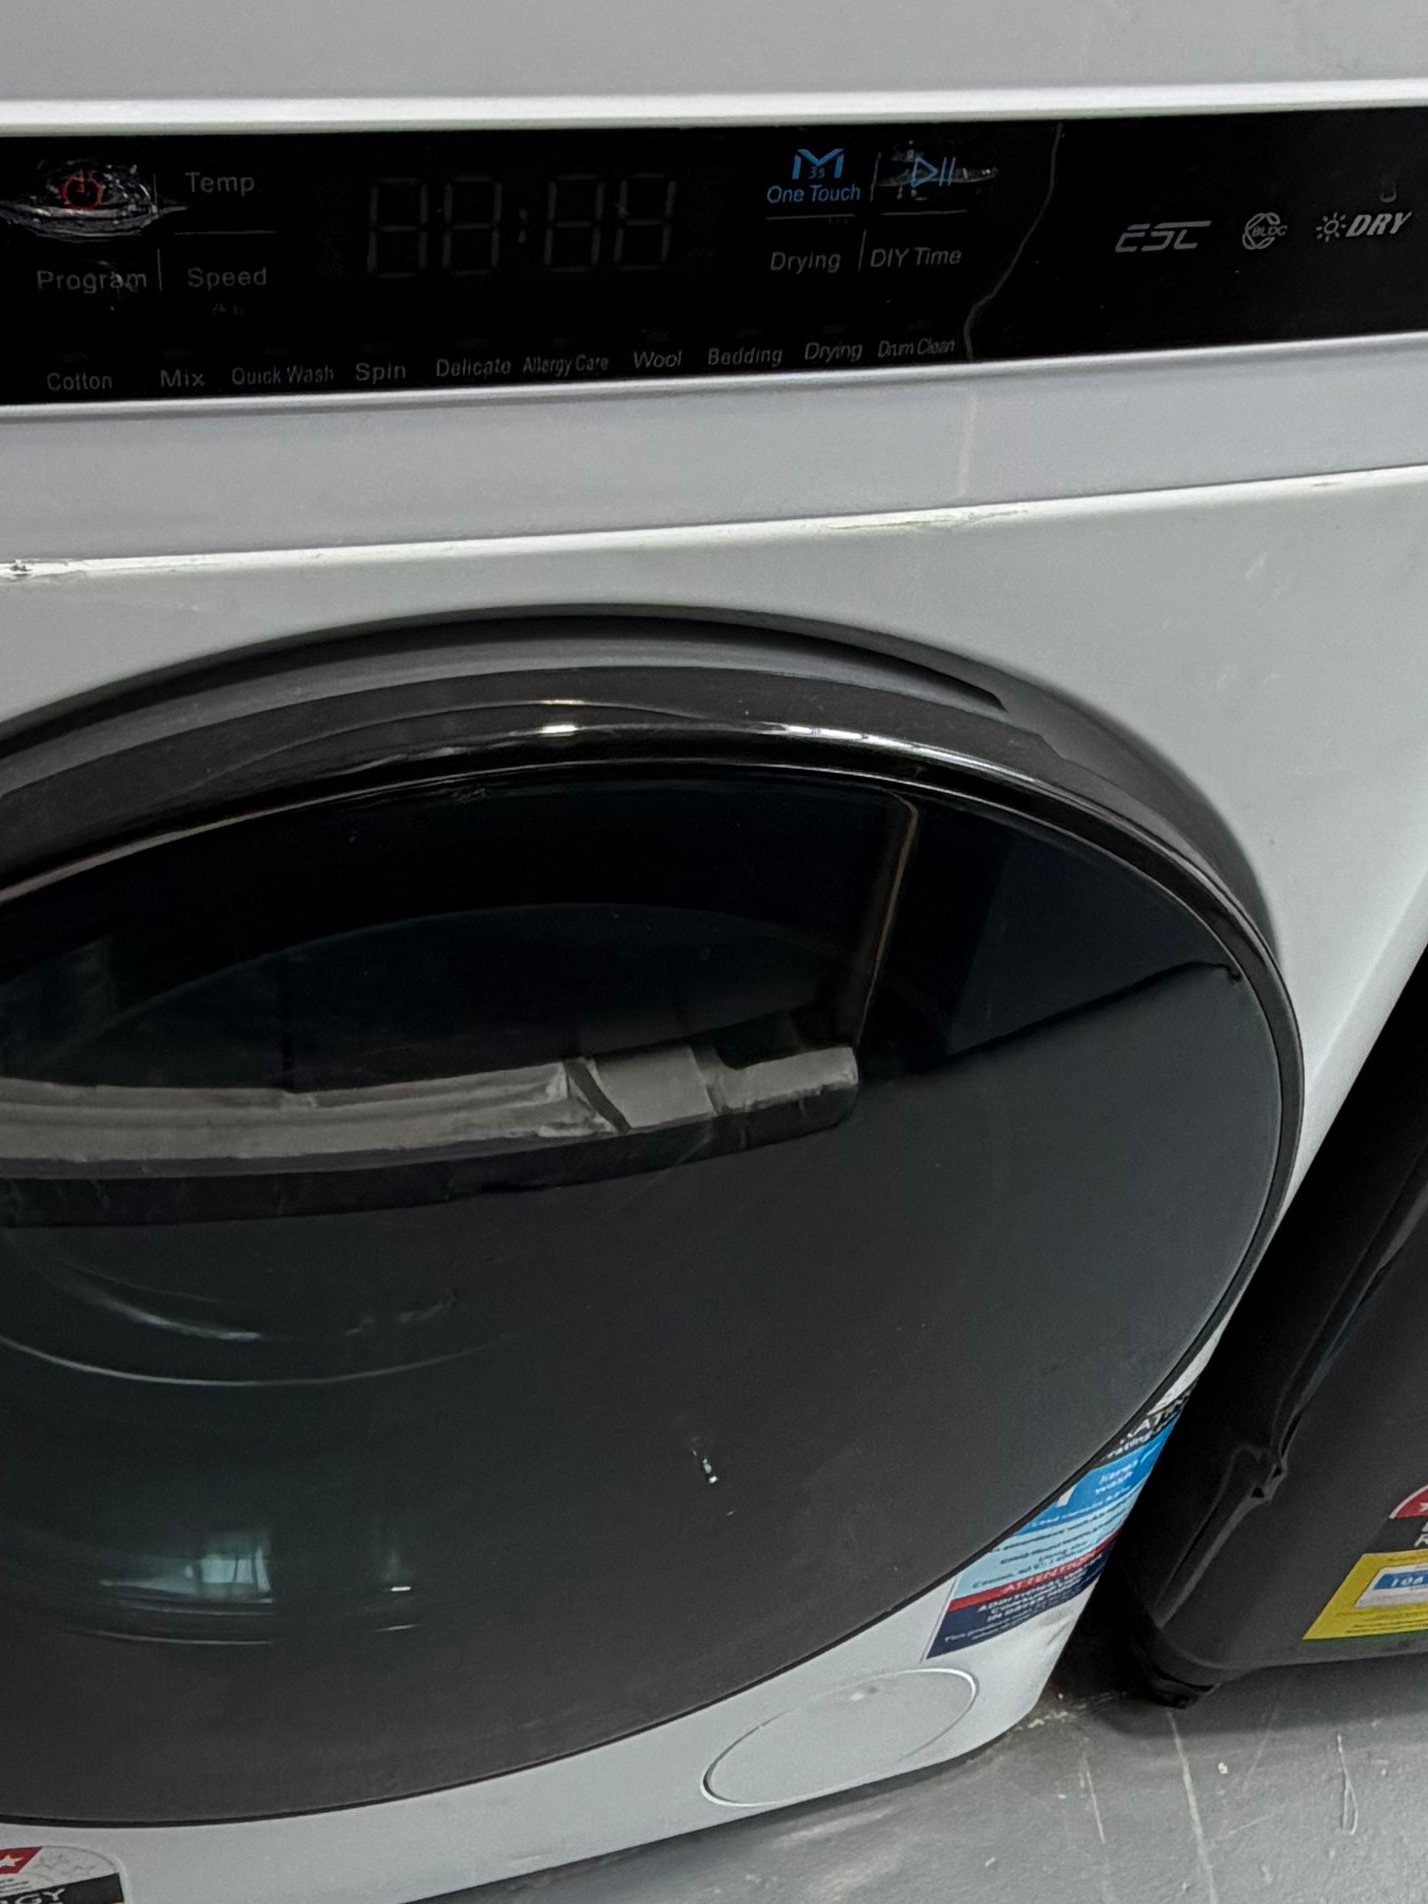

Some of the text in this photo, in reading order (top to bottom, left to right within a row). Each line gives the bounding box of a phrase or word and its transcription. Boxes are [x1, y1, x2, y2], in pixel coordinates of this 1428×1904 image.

[186, 171, 256, 197] Temp
[766, 184, 862, 204] One Touch
[1345, 211, 1413, 238] DRY
[770, 247, 963, 275] Drying DIY Time
[36, 267, 268, 296] Program Speed
[708, 345, 783, 368] Bedding
[804, 340, 864, 364] Drying
[917, 337, 956, 356] Clean
[436, 357, 512, 380] Delicate
[522, 354, 610, 380] Allergy Care
[633, 350, 683, 369] Wool
[46, 371, 113, 392] Cotton
[160, 369, 206, 389] Mix
[231, 364, 335, 387] Quick Wash
[355, 362, 407, 385] Spin
